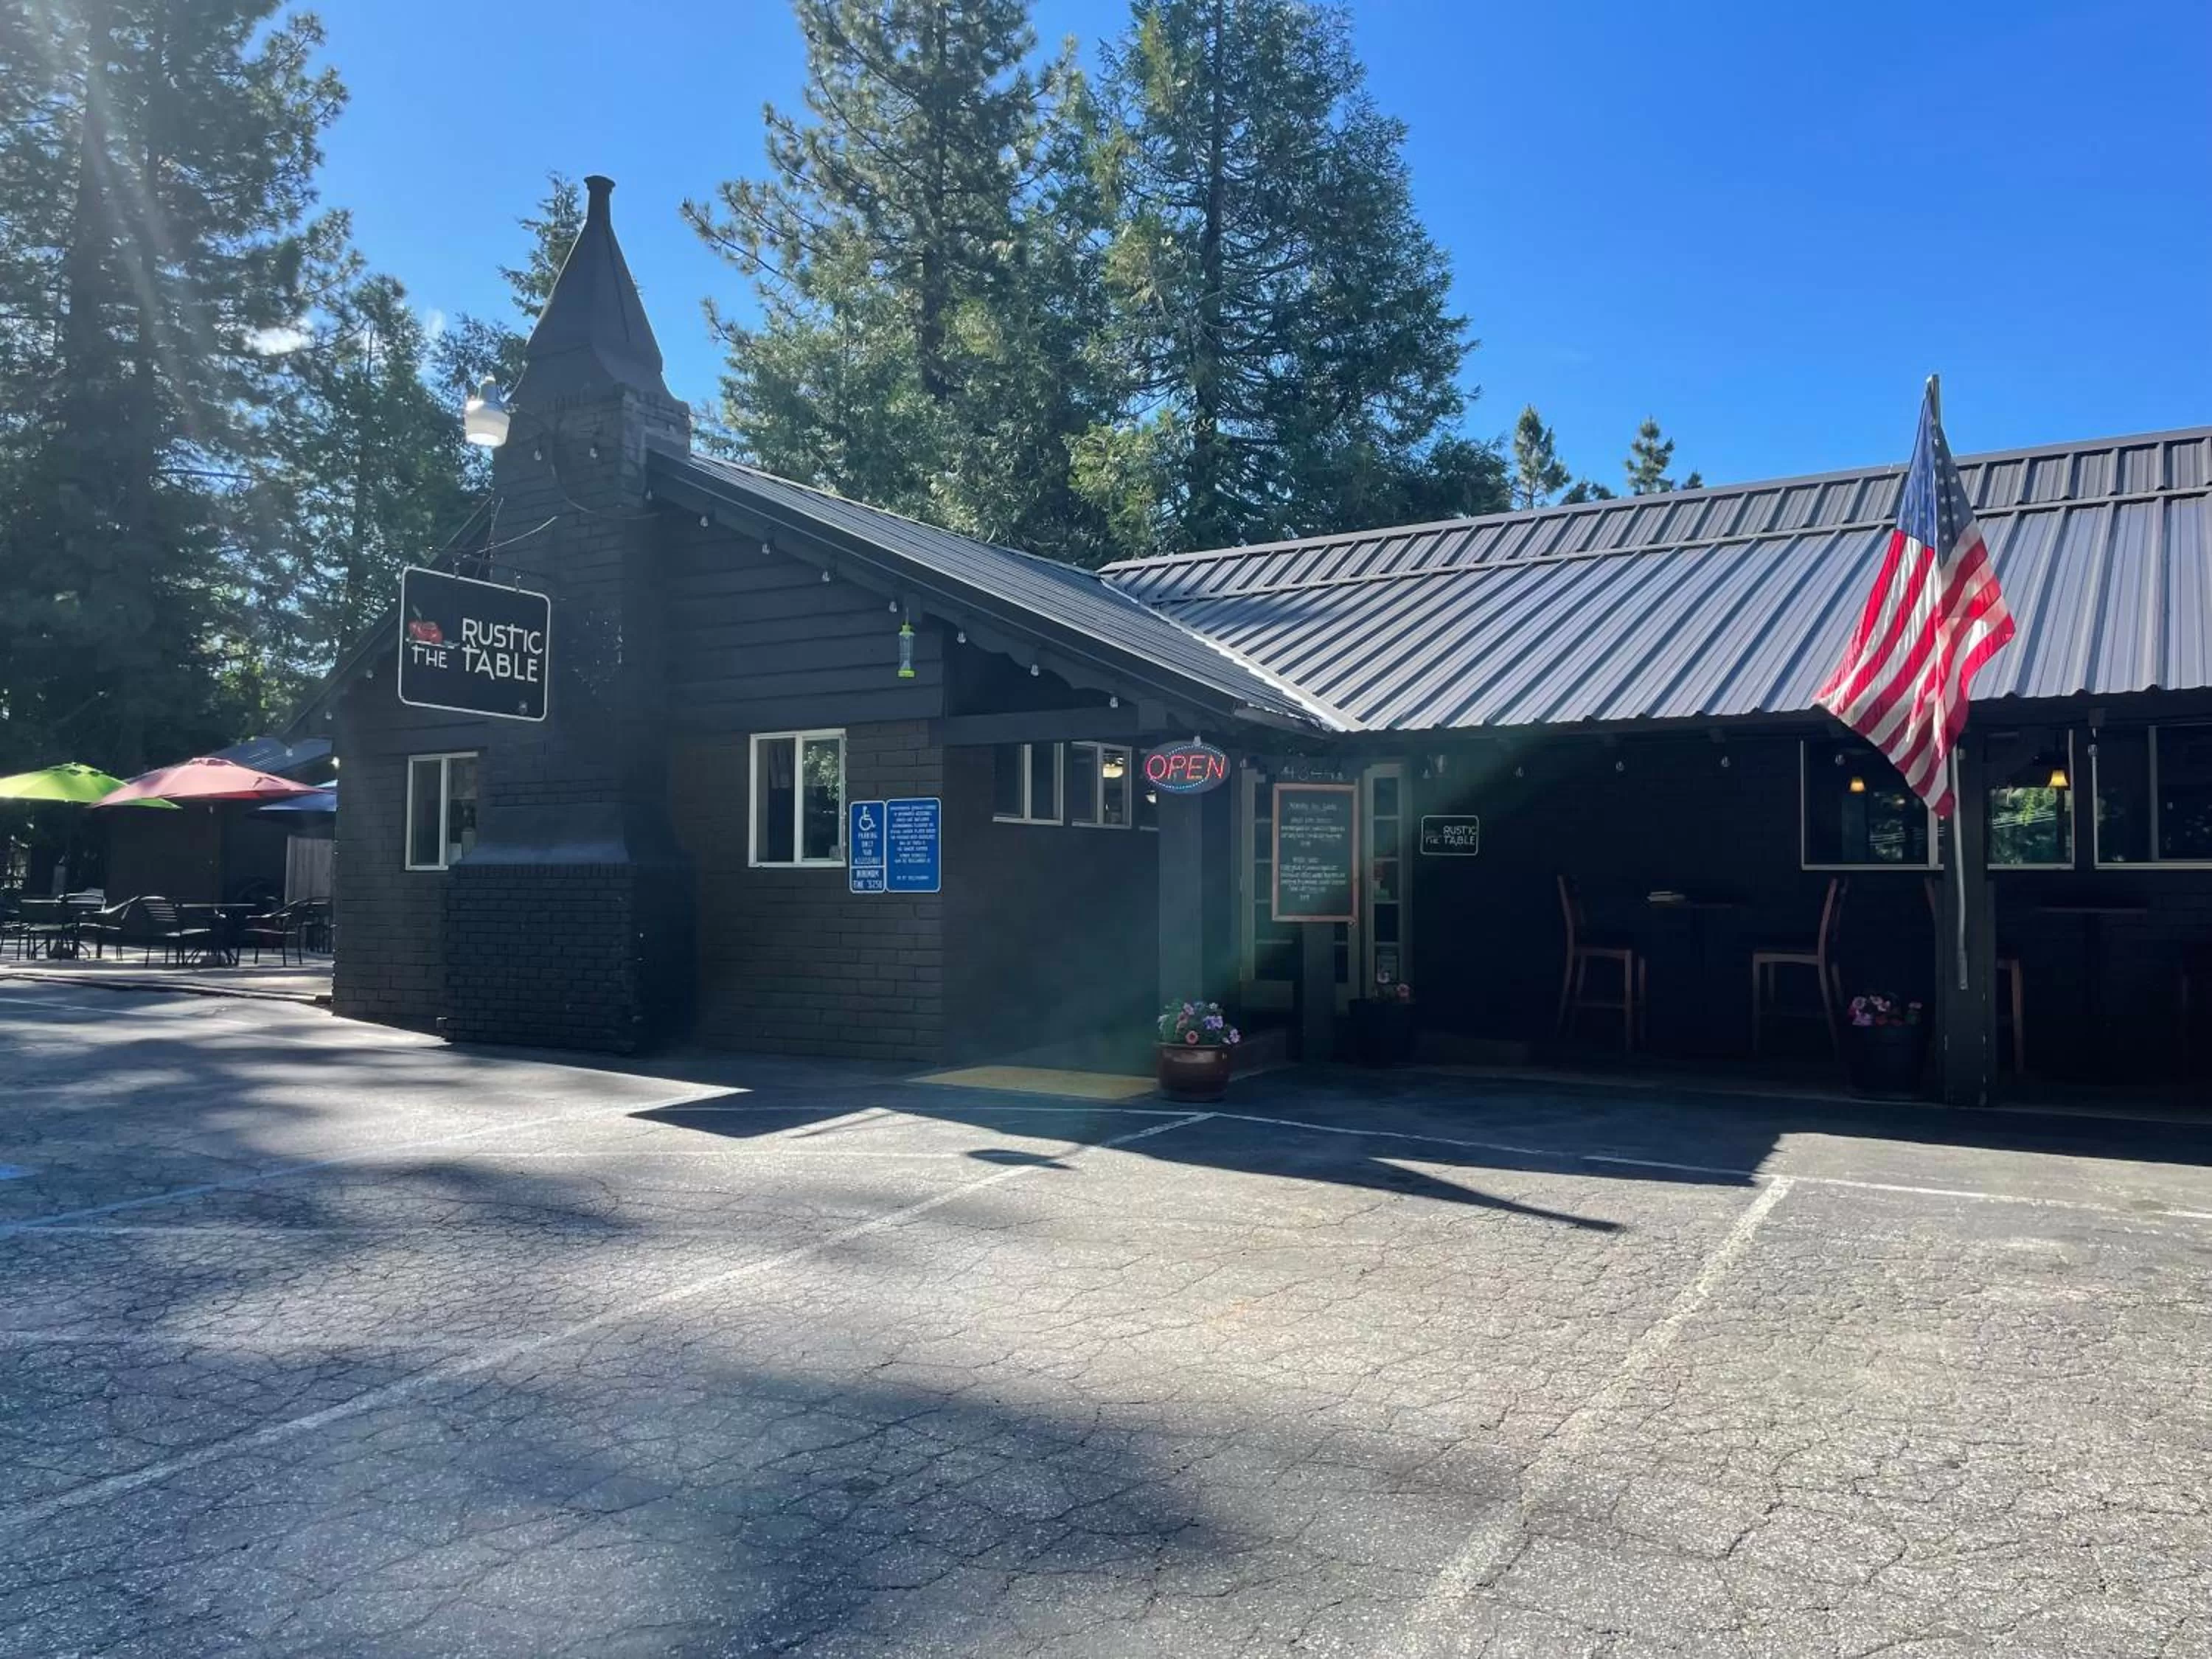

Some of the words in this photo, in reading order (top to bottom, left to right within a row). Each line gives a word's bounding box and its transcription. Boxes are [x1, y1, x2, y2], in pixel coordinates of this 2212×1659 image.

[462, 617, 543, 655] RUSTIC
[411, 644, 448, 668] THE
[462, 644, 538, 682] TABLE
[1146, 754, 1225, 779] OPEN
[1443, 825, 1477, 835] RUSTIC
[1443, 835, 1475, 846] TABLE
